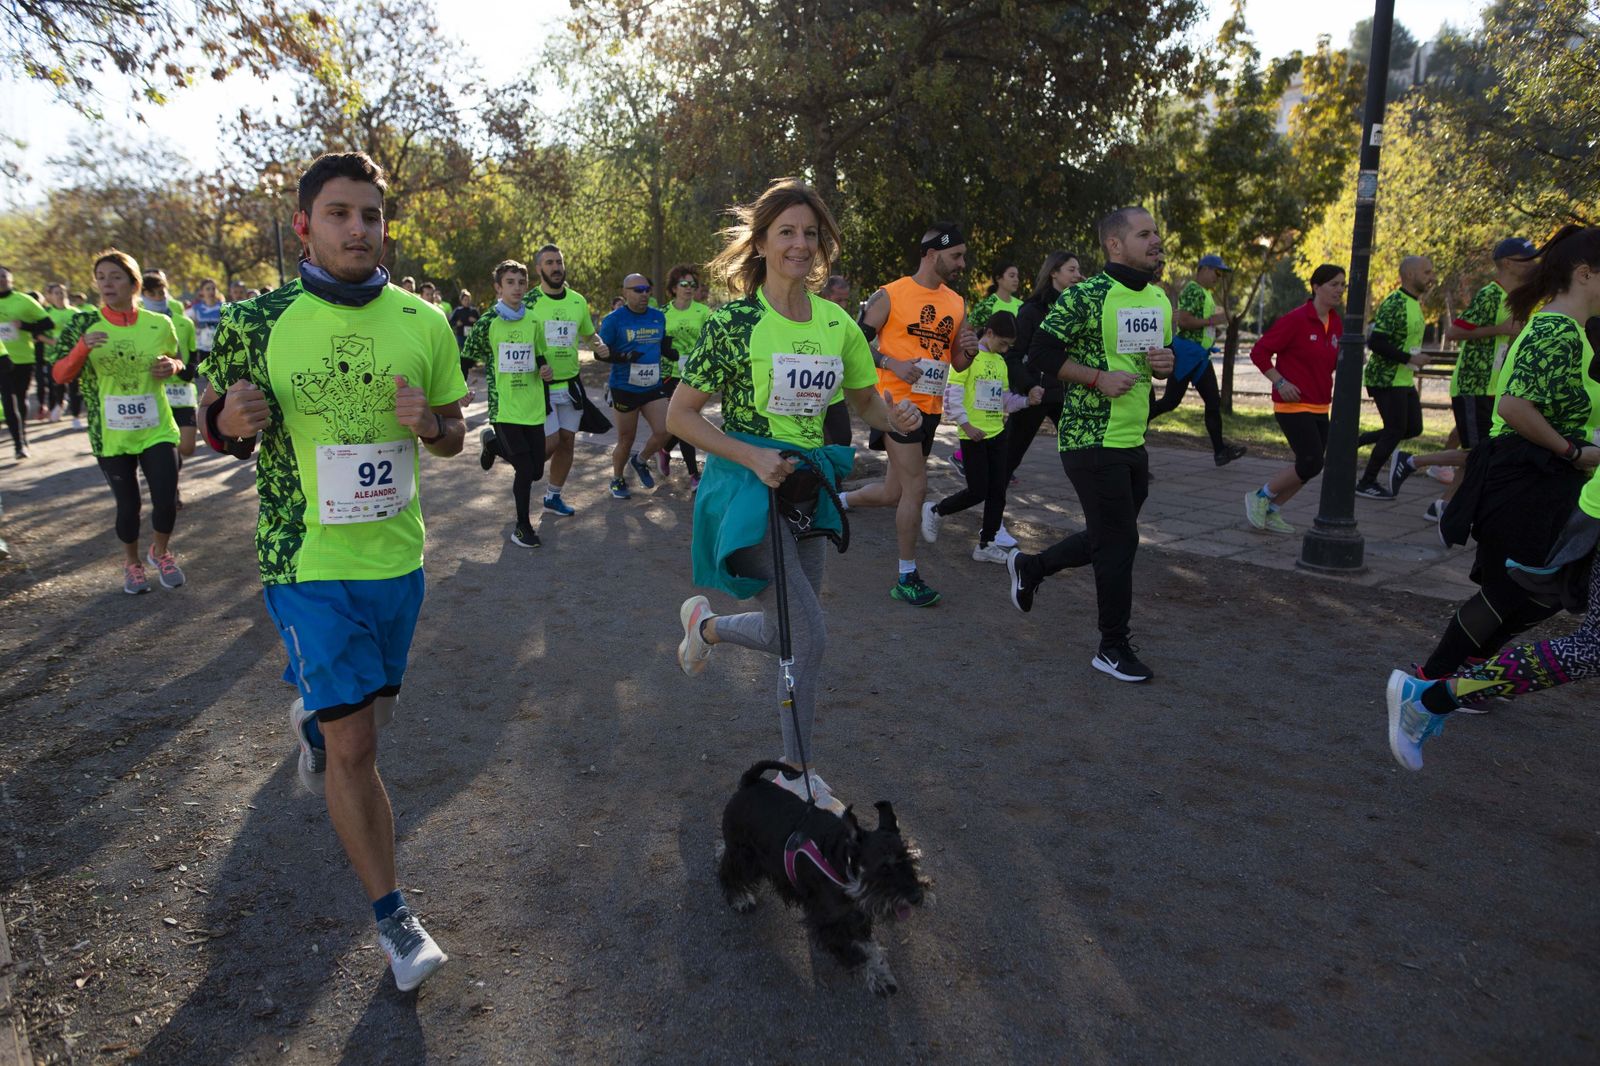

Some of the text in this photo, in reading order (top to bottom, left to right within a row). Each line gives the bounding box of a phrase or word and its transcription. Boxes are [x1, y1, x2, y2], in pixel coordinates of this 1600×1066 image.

[557, 326, 569, 336] 18
[1125, 318, 1158, 333] 1664
[505, 350, 531, 360] 1077
[638, 369, 654, 377] 444
[787, 368, 836, 390] 1040
[925, 367, 945, 380] 464
[117, 402, 146, 415] 886
[358, 460, 393, 487] 92
[354, 487, 397, 499] ALEJANDRO
